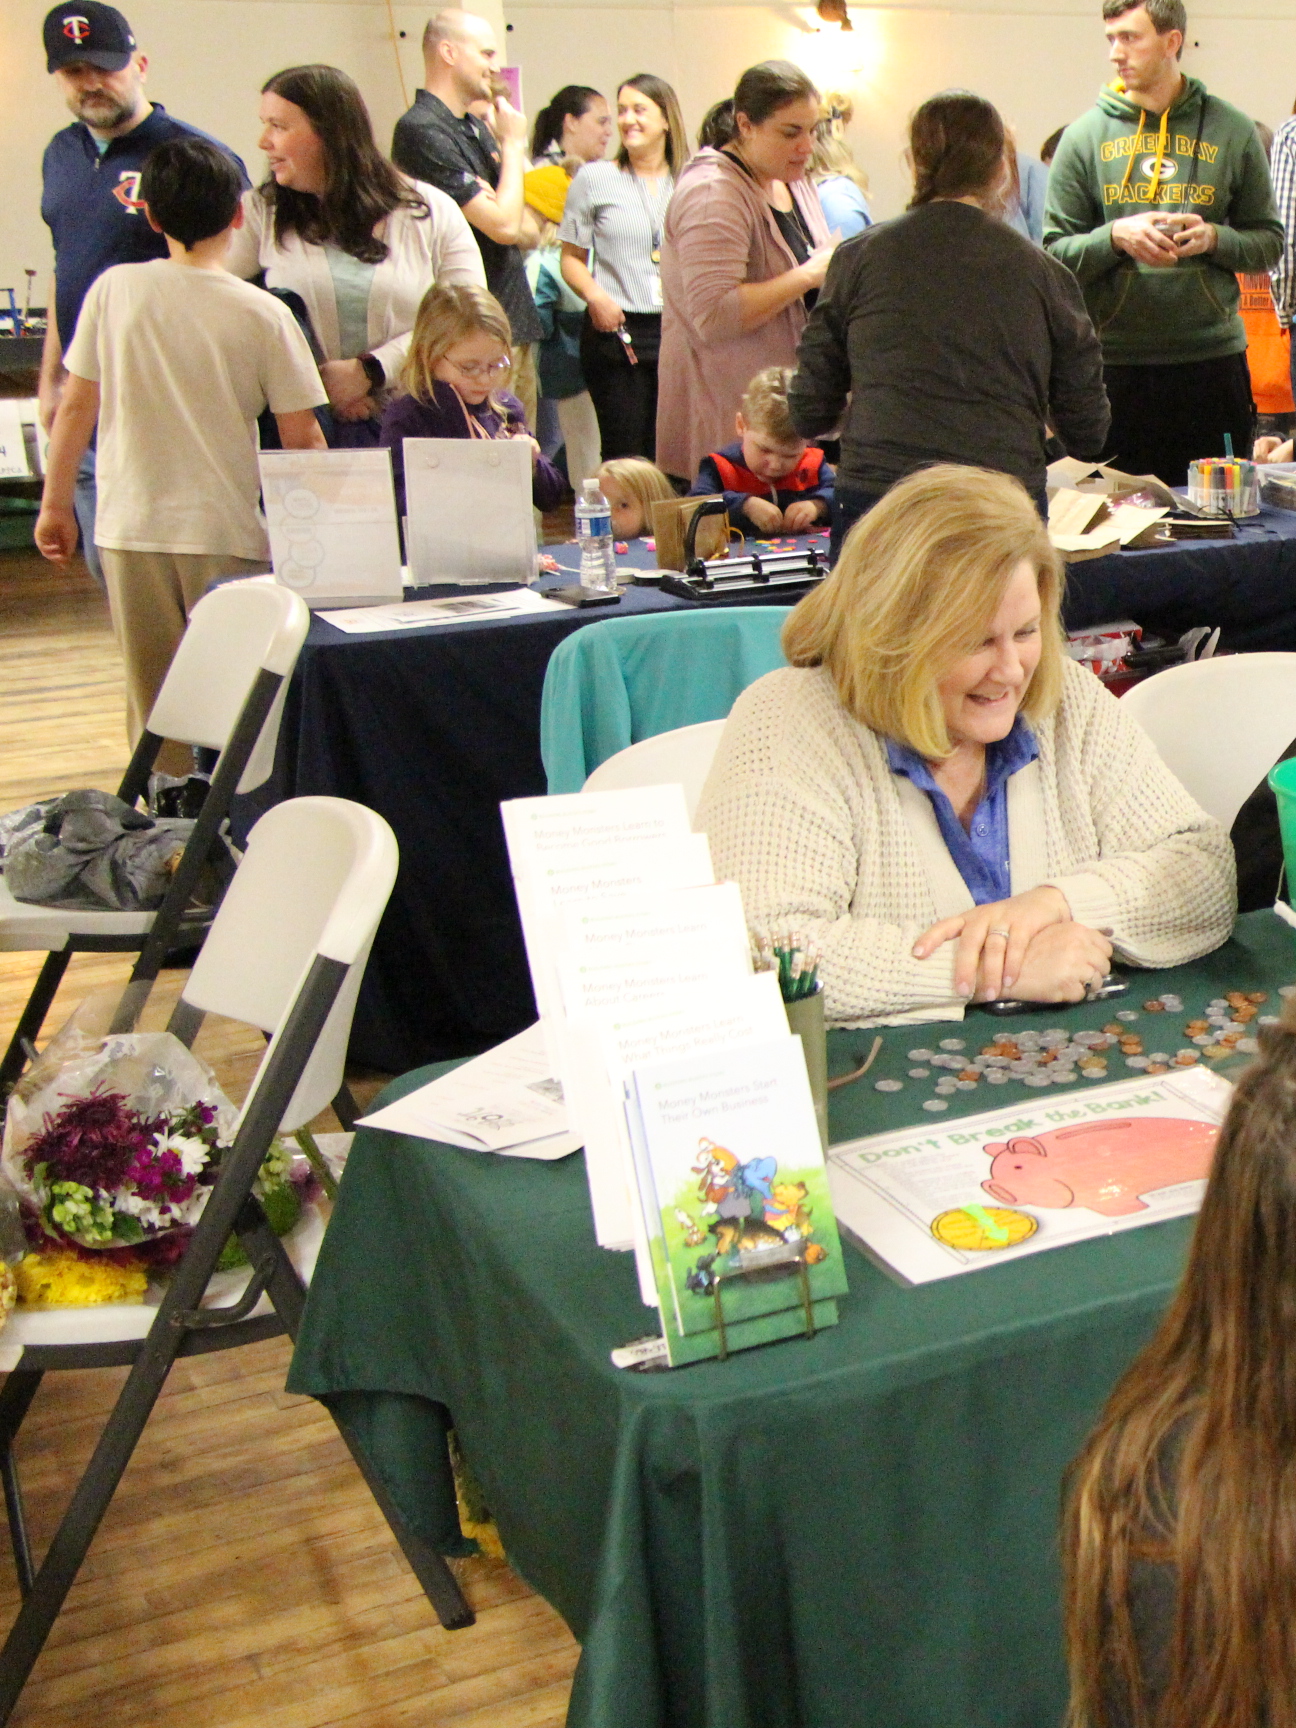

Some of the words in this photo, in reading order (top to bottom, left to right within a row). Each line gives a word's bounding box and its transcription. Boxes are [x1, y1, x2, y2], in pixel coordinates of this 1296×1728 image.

[1100, 133, 1171, 162] GREEN
[1175, 134, 1219, 163] BAY
[1104, 182, 1217, 205] PACKERS
[533, 829, 569, 841] Money
[572, 824, 621, 836] Monsters
[550, 884, 589, 896] Money
[591, 875, 642, 889] Monsters
[584, 932, 623, 943] Money
[625, 926, 676, 938] Monsters
[677, 922, 708, 934] Learn
[582, 981, 621, 993] Money
[624, 974, 676, 989] Monsters
[678, 971, 708, 982] Learn
[584, 995, 620, 1007] About
[618, 1036, 657, 1050] Money
[659, 1023, 711, 1041] Monsters
[713, 1015, 744, 1029] Learn
[621, 1051, 651, 1064] What
[654, 1041, 691, 1057] Things
[693, 1031, 726, 1047] Really
[728, 1025, 754, 1040] Cost
[658, 1095, 696, 1111] Money
[698, 1085, 751, 1102] Monsters
[752, 1077, 777, 1092] Start
[661, 1112, 689, 1125] Their
[691, 1105, 719, 1119] Own
[721, 1095, 769, 1113] Business
[858, 1137, 940, 1165] Don't
[946, 1116, 1040, 1146] Break
[1044, 1103, 1088, 1123] the
[1084, 1090, 1169, 1115] Bank!
